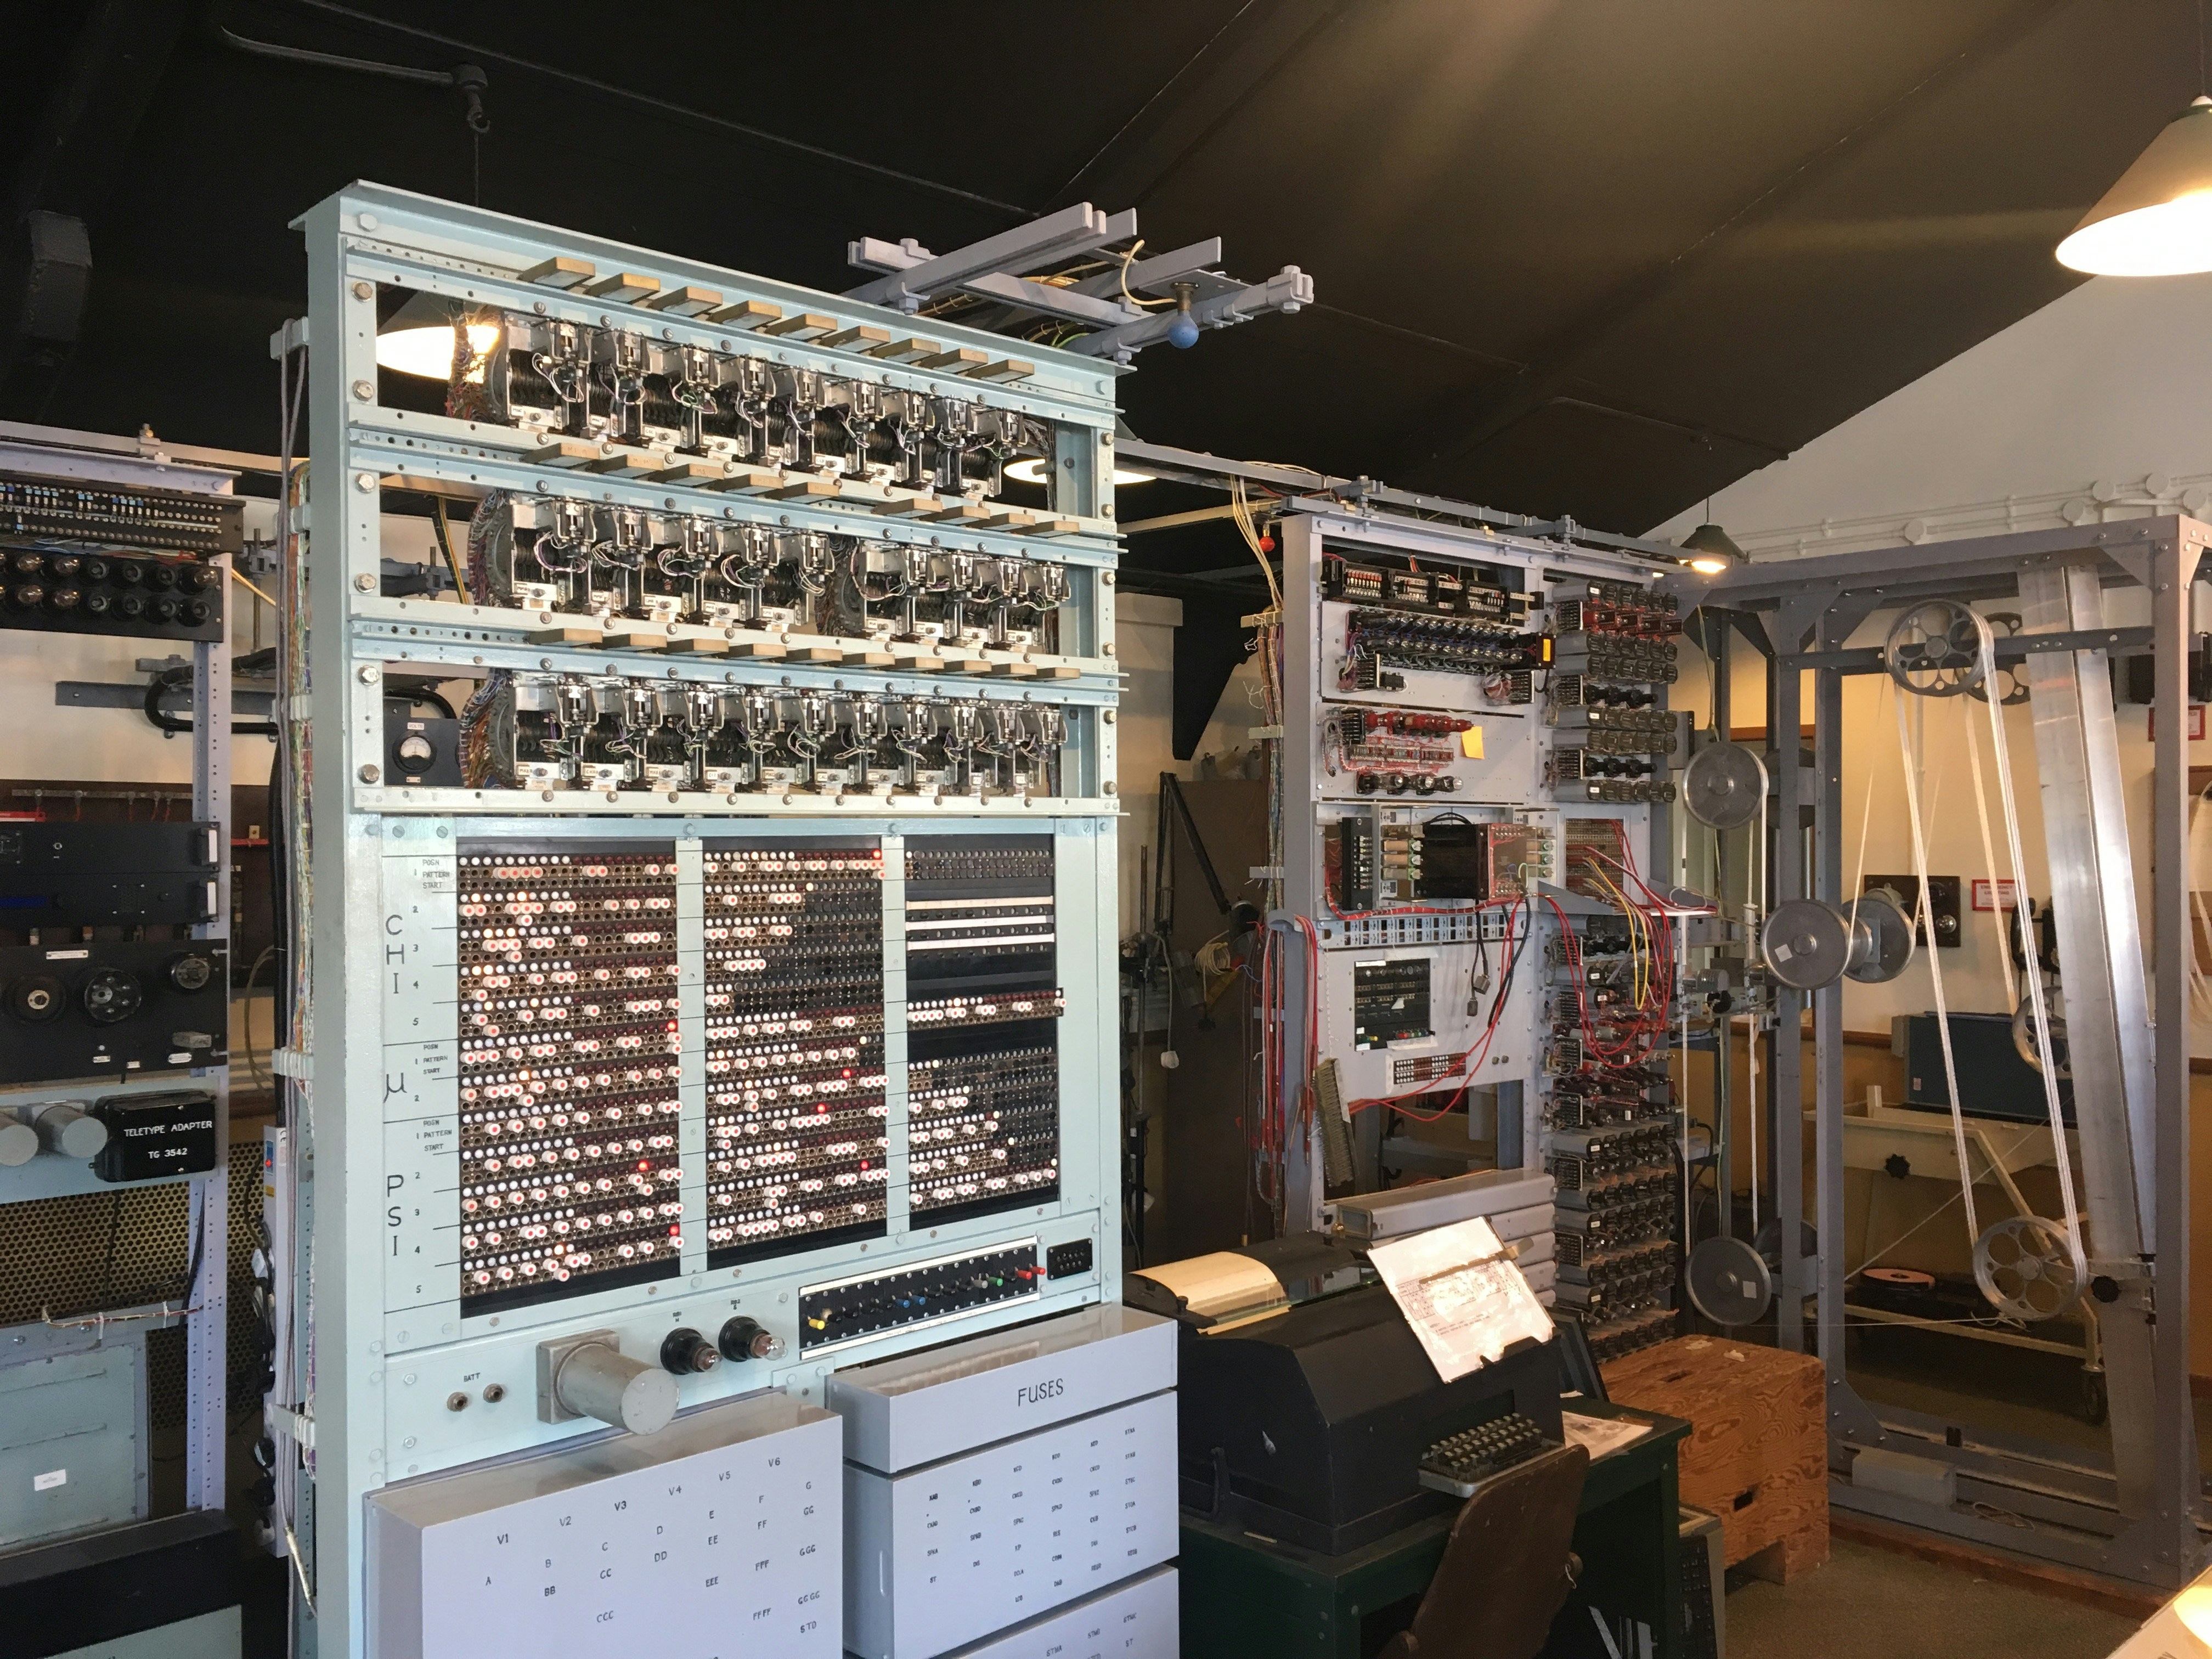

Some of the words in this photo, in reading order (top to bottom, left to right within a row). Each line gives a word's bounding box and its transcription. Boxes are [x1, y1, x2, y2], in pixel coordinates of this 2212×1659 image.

[413, 981, 419, 989] 4
[413, 1018, 419, 1026] 5
[123, 1125, 165, 1137] TELETYPE
[171, 1121, 212, 1132] ADAPTER
[424, 1130, 452, 1138] PATTERN
[164, 1148, 187, 1156] 3542
[464, 1373, 480, 1382] BATT
[1018, 1378, 1063, 1407] FUSES
[769, 1457, 780, 1467] V6
[719, 1471, 730, 1481] V5
[806, 1481, 811, 1489] G
[669, 1486, 681, 1496] V4
[614, 1500, 627, 1511] V3
[804, 1505, 814, 1515] GG
[709, 1510, 714, 1519] E
[560, 1516, 571, 1526] V2
[758, 1520, 767, 1530] FF
[657, 1526, 663, 1534] D
[497, 1533, 508, 1544] V1
[708, 1535, 718, 1545] EE
[602, 1542, 608, 1551] C
[800, 1545, 815, 1556] GGG
[654, 1551, 667, 1562] DD
[545, 1559, 551, 1568] B
[755, 1560, 769, 1571] FFF
[600, 1568, 611, 1579] CC
[486, 1577, 491, 1585] A
[706, 1577, 718, 1587] EEE
[545, 1585, 555, 1596] BB
[597, 1611, 613, 1623] CCC
